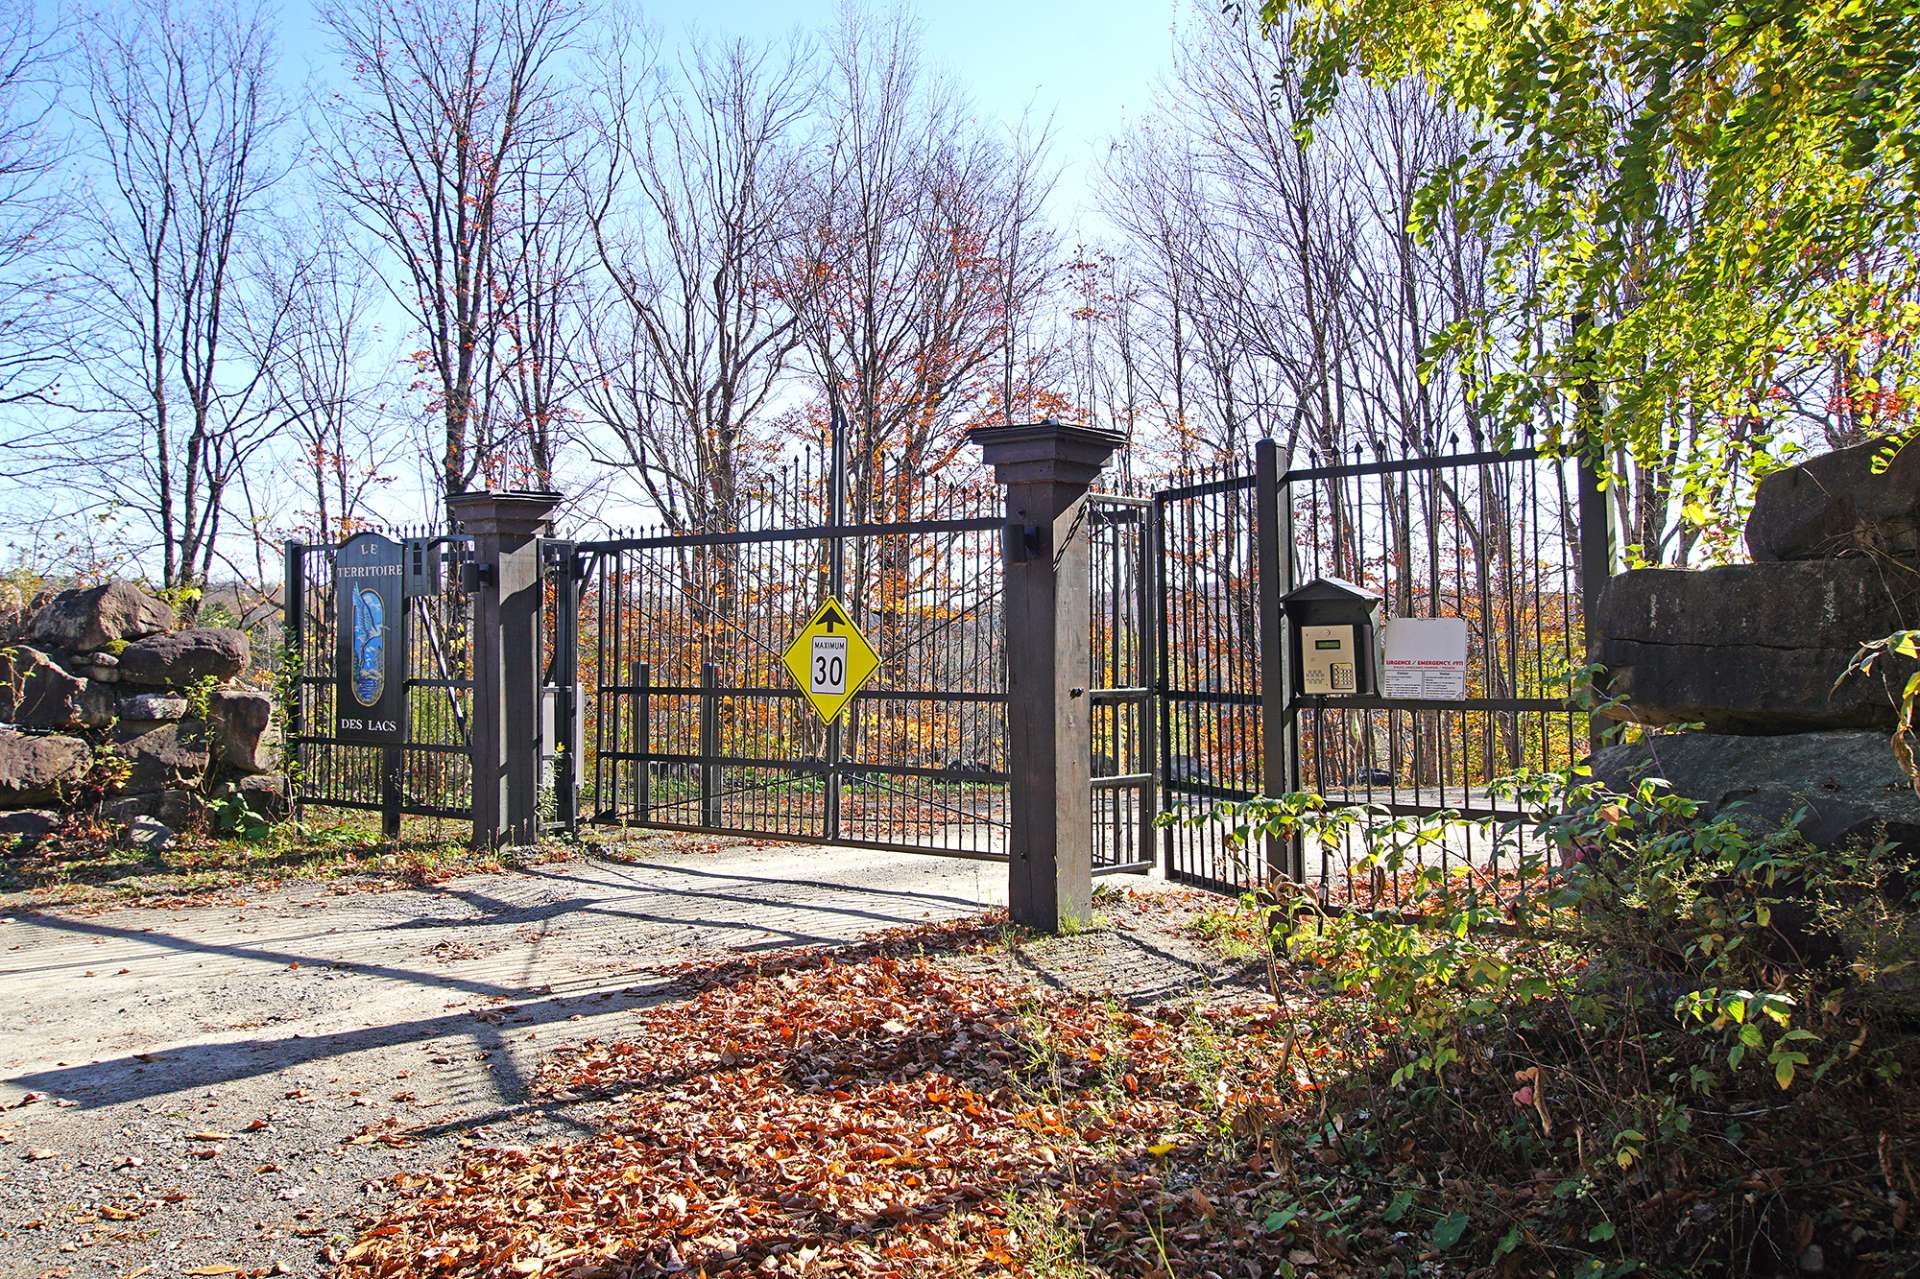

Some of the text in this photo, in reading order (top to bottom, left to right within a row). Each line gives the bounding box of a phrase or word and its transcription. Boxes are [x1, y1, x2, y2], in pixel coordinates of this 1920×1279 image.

[361, 544, 378, 555] LE
[337, 565, 403, 578] TERRITOIRE
[814, 656, 843, 686] 30
[341, 718, 397, 732] DES LACS
